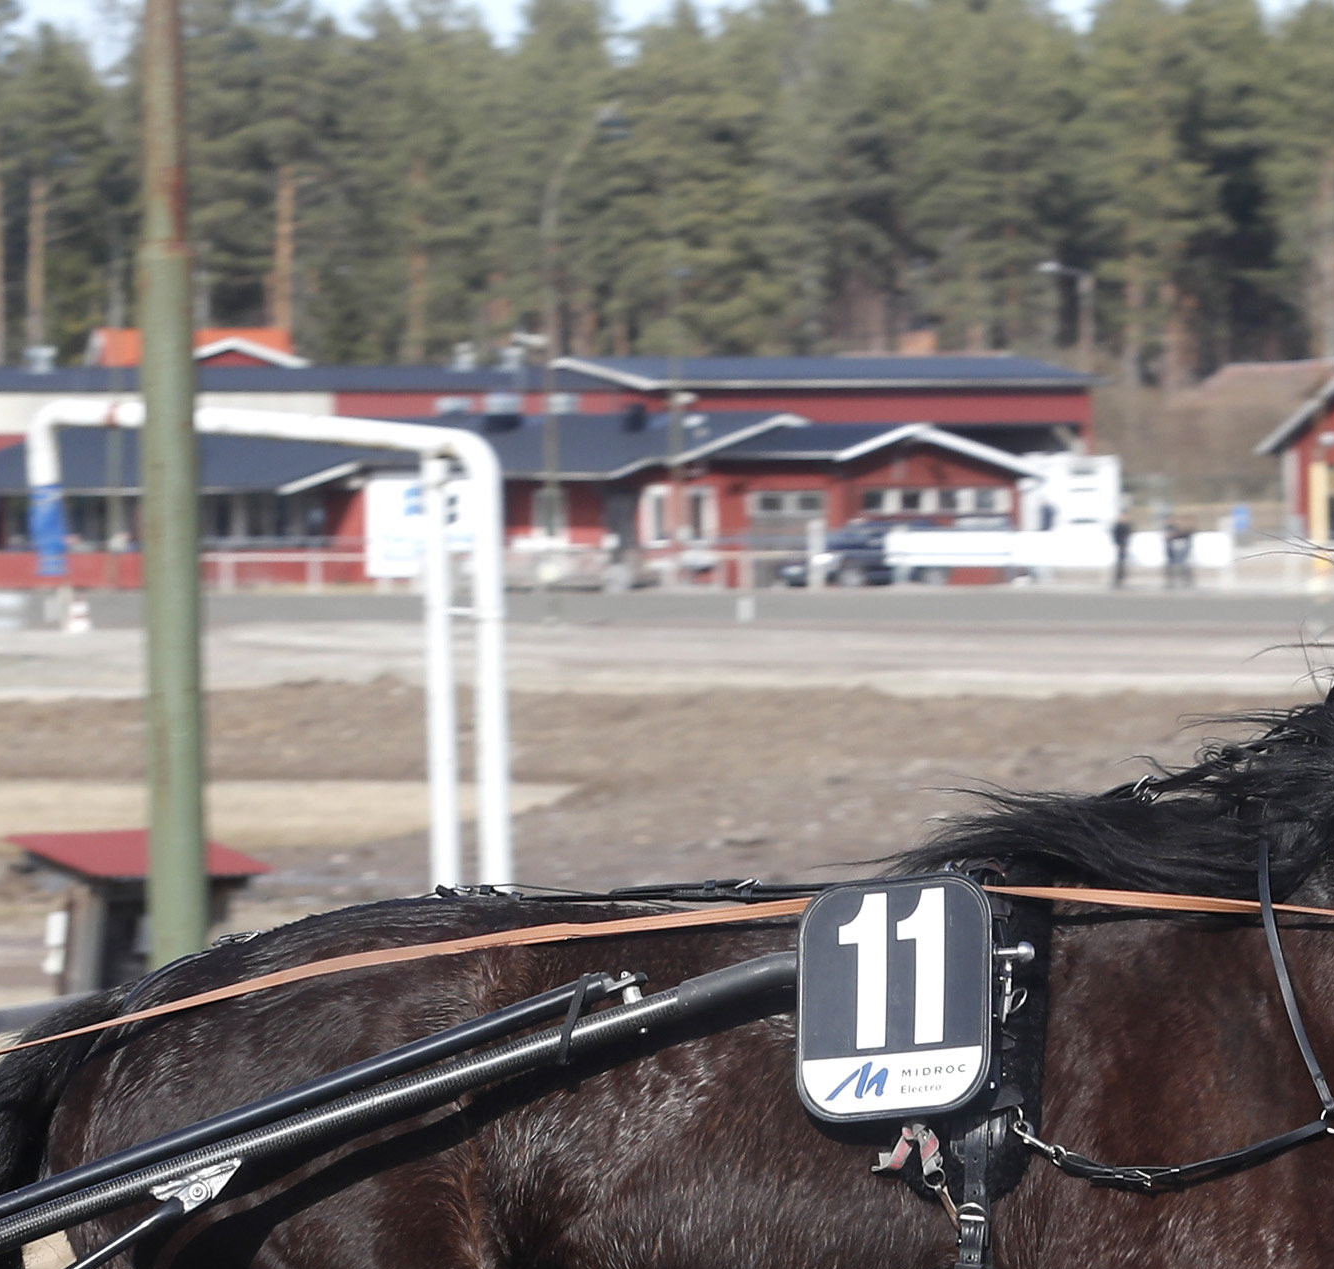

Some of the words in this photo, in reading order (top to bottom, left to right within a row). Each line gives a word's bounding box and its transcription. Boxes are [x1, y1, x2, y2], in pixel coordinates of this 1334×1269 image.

[838, 887, 945, 1050] 11
[901, 1063, 966, 1078] MIDROC
[900, 1084, 942, 1095] Electro
